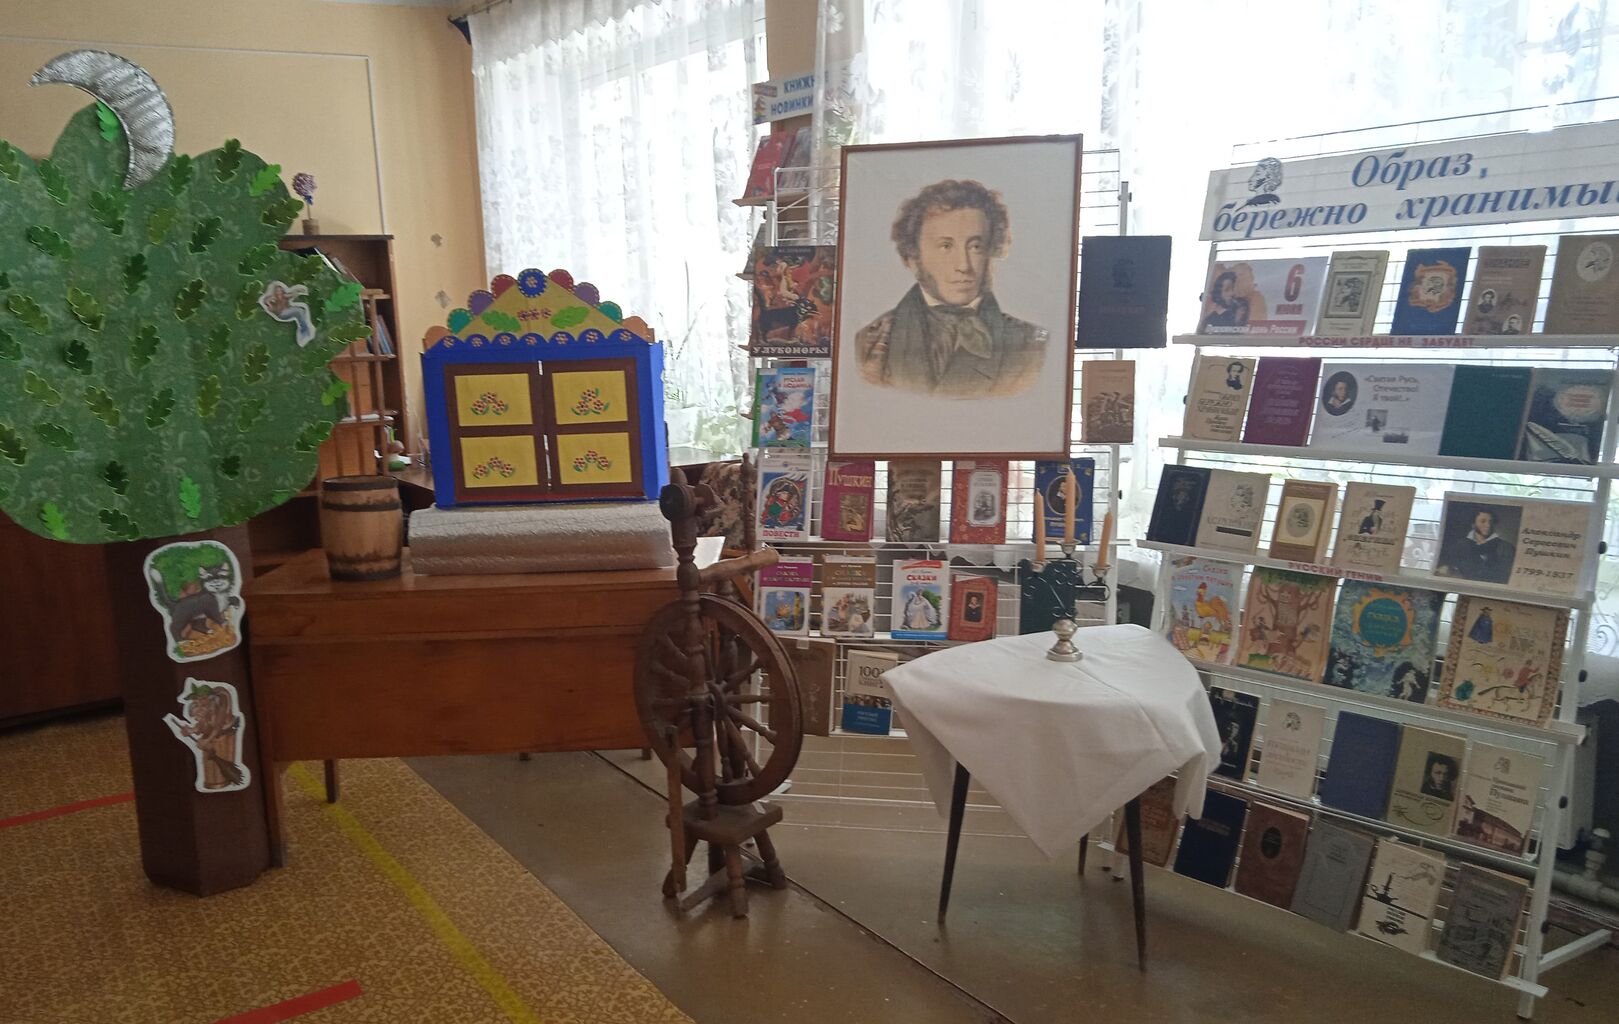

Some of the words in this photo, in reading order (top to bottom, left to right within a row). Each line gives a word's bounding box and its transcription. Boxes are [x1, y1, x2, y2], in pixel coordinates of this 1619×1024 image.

[1351, 148, 1487, 191] Образ,
[1213, 201, 1369, 238] бережно
[1395, 180, 1619, 226] хранимы
[1284, 263, 1306, 302] 6
[752, 346, 761, 354] У
[761, 346, 829, 354] ЛУКОМОРЬЯ
[1298, 336, 1347, 346] РОССИИ
[1397, 337, 1412, 346] НЕ
[1421, 337, 1475, 347] ЗАБУДЕТ
[762, 529, 801, 538] ПОВЕСТИ
